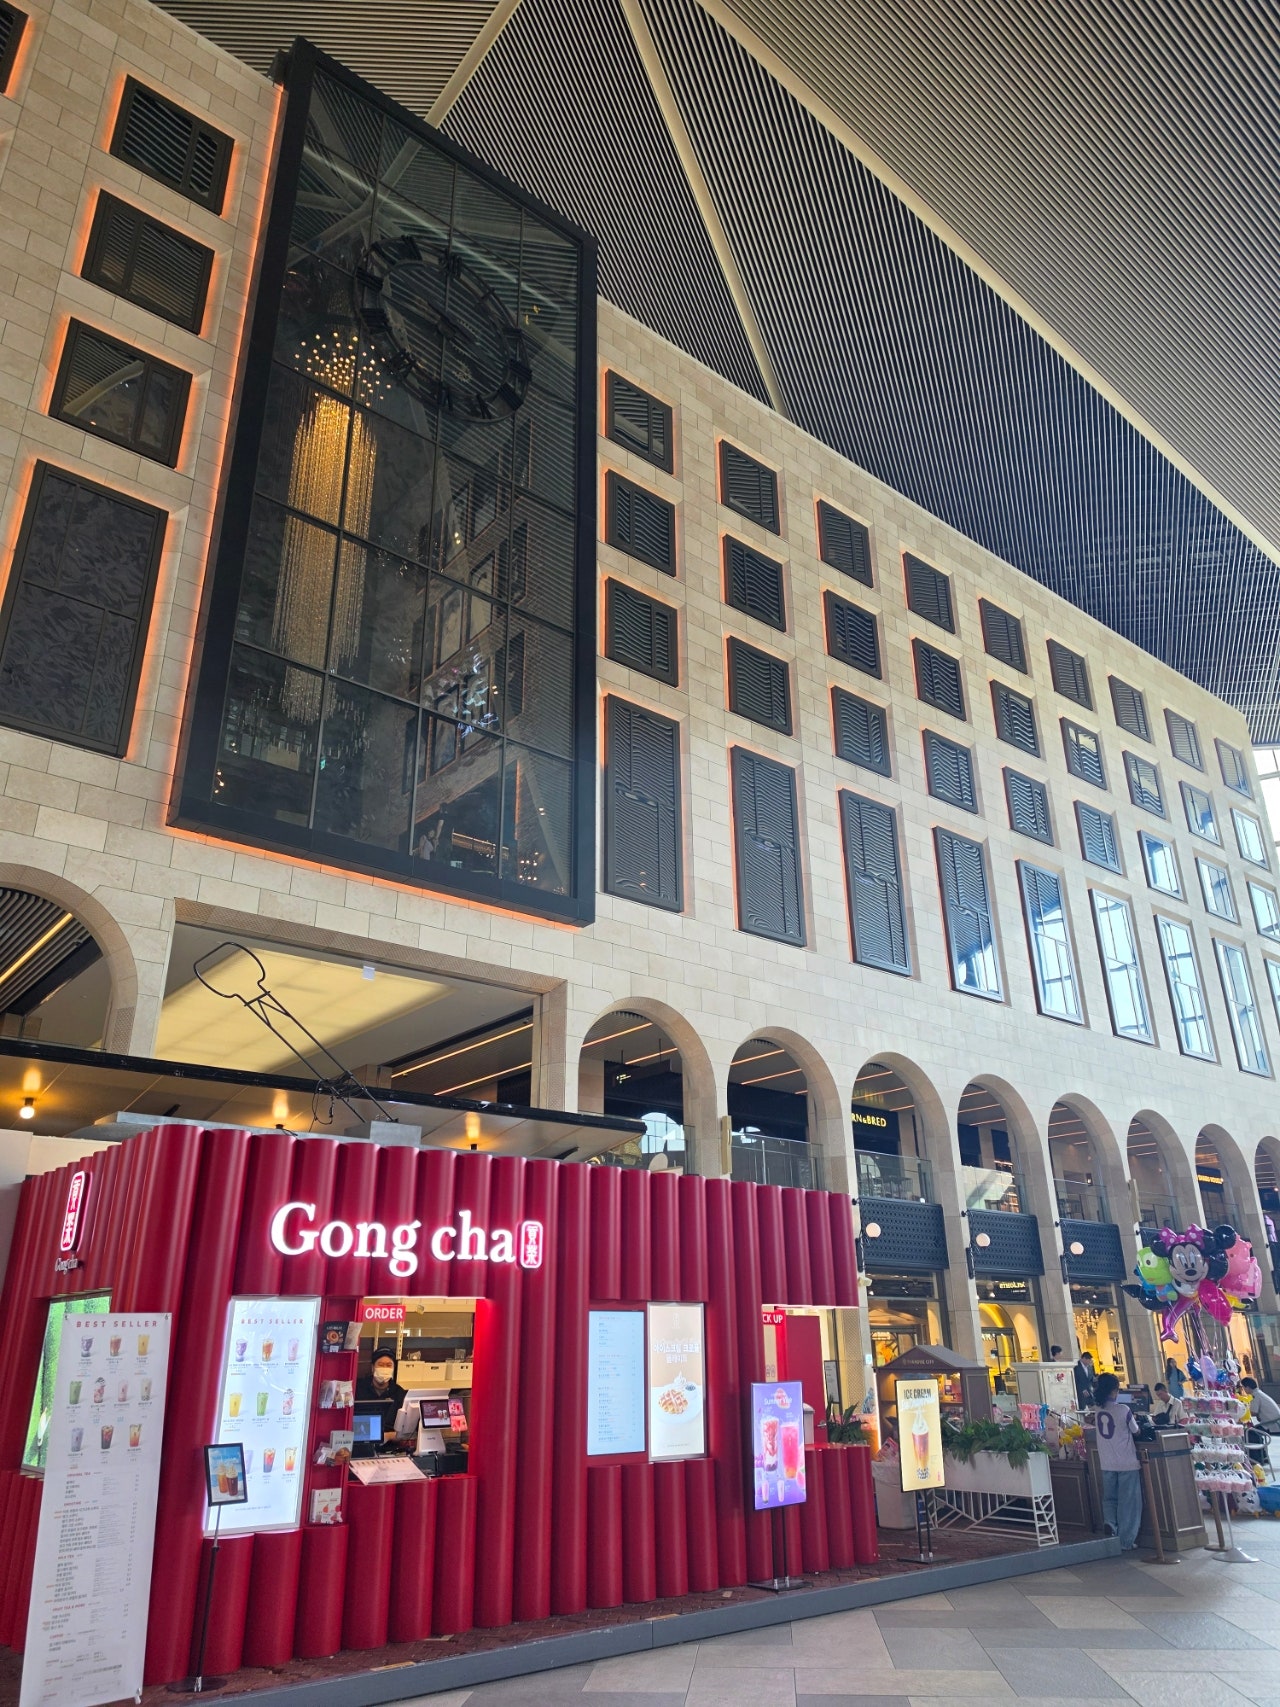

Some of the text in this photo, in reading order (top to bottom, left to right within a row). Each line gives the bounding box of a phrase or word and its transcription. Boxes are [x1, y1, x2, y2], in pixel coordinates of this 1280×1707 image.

[851, 1113, 887, 1127] RN&BRED
[270, 1202, 516, 1277] Gong cha
[55, 1258, 69, 1275] Gong
[365, 1307, 403, 1319] ORDER
[763, 1314, 783, 1324] CK UP
[904, 1388, 931, 1399] ICE CREAM
